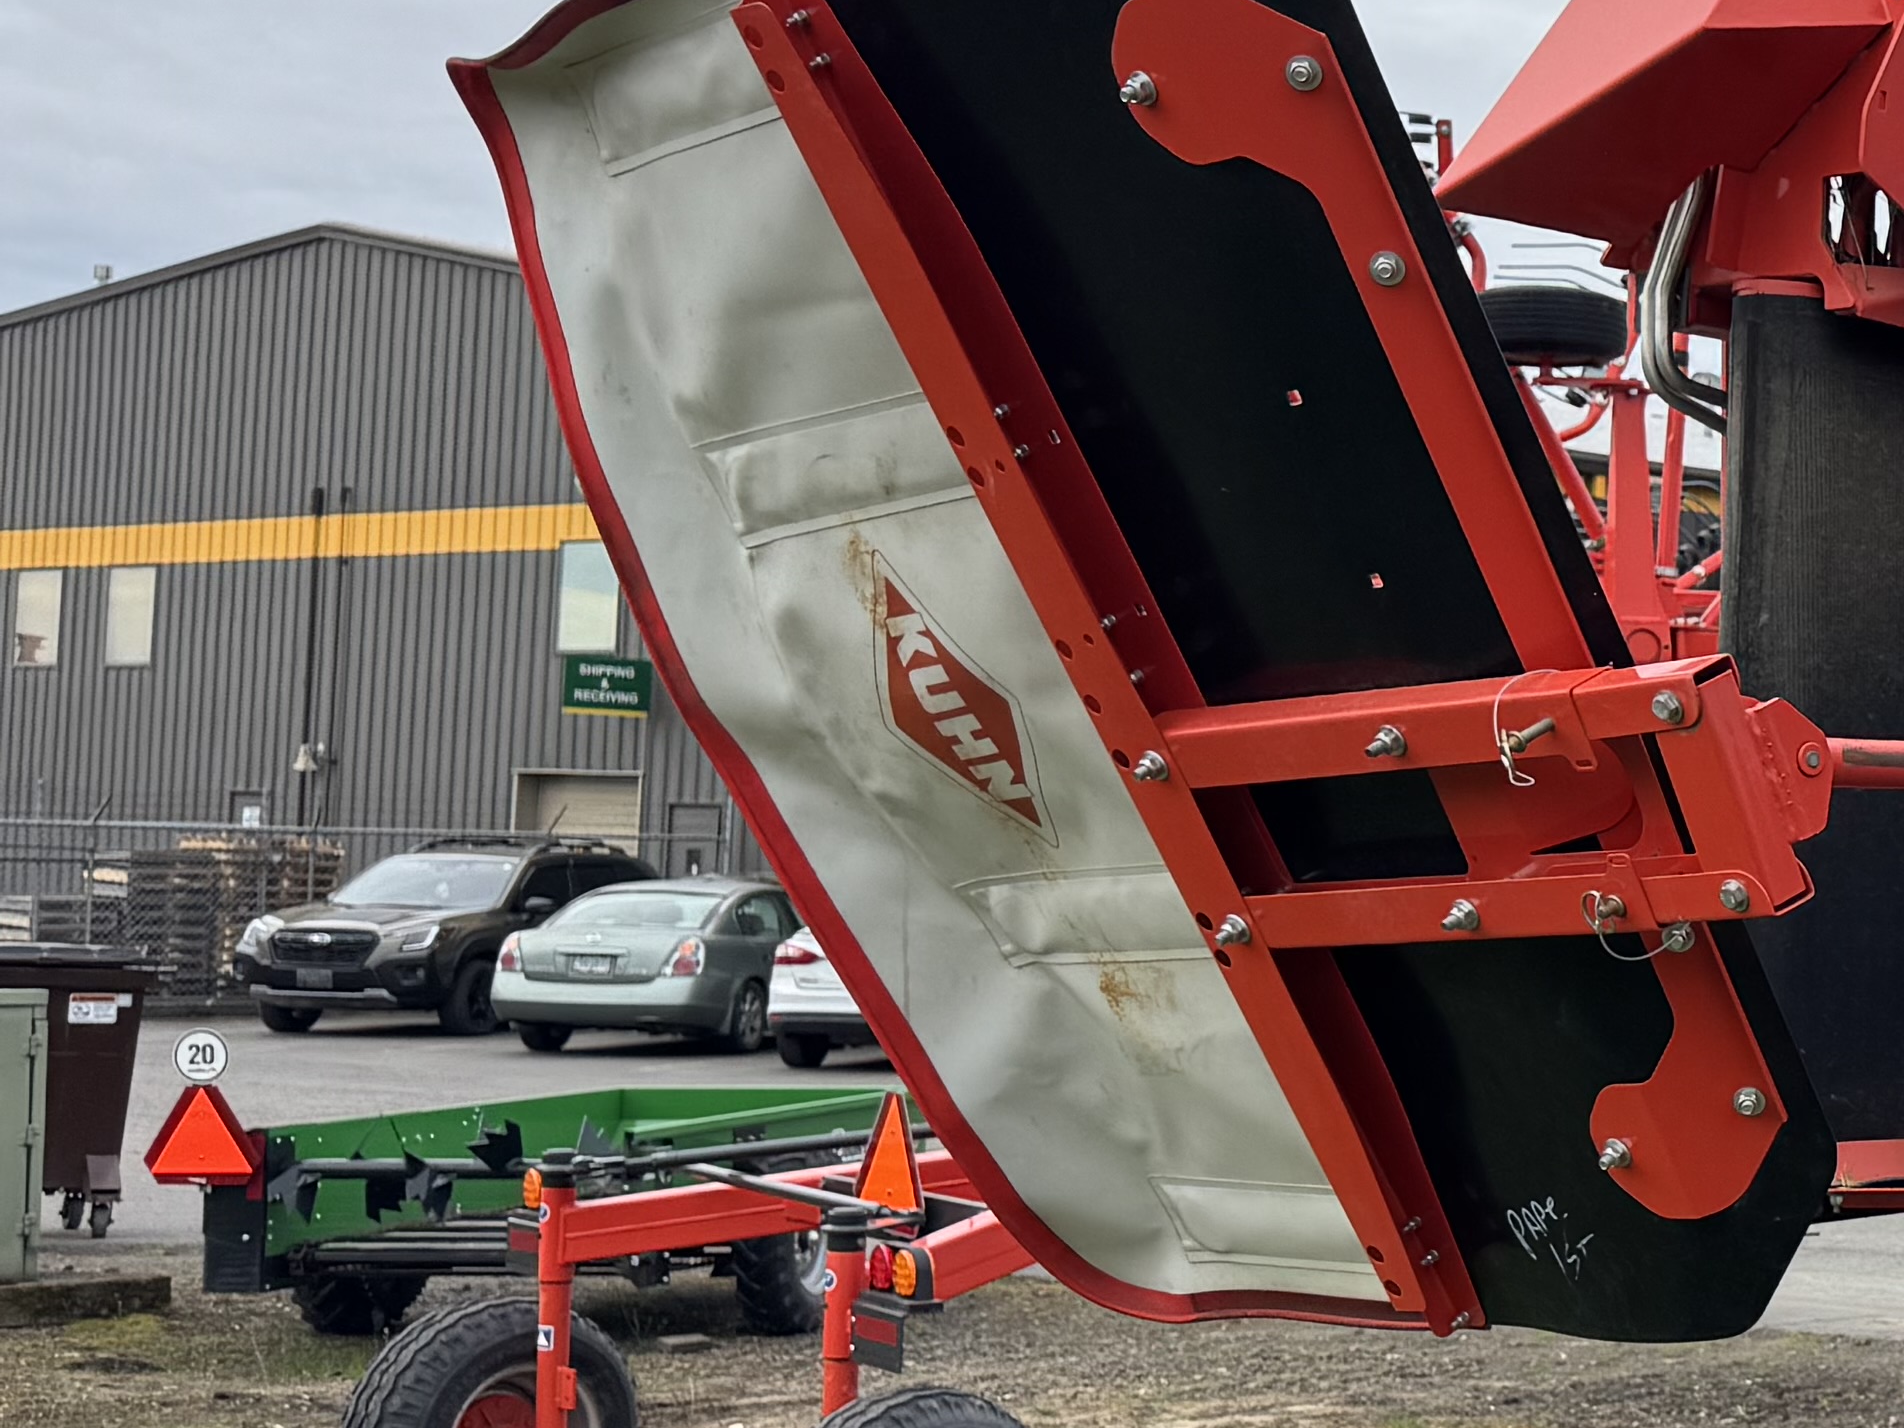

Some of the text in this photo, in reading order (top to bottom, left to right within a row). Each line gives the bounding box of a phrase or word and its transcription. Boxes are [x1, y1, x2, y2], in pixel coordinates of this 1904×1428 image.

[579, 663, 635, 679] SHIPPING
[573, 688, 638, 705] RECEIVING
[885, 612, 1034, 802] KUHN
[188, 1043, 215, 1065] 20
